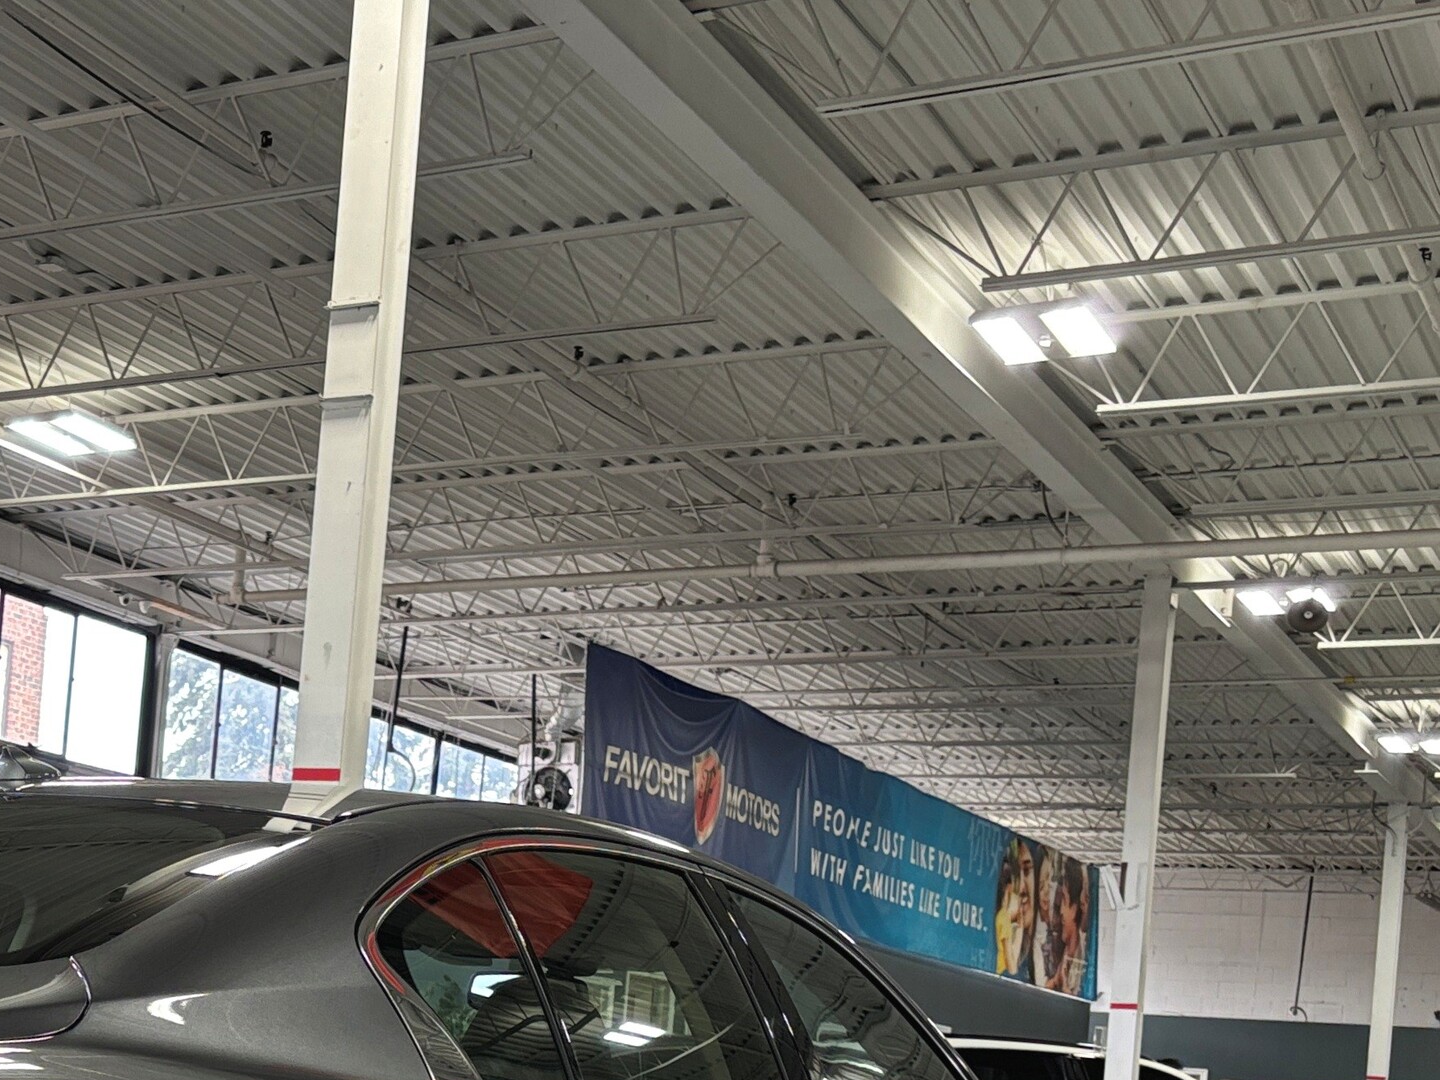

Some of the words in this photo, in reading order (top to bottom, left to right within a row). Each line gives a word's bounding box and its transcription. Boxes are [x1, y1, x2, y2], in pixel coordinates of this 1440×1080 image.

[603, 745, 690, 804] FAVORIT
[725, 783, 780, 837] MOTORS
[811, 847, 848, 886] WITH
[853, 864, 915, 909] FAMILIES
[918, 887, 940, 918] LIKE
[945, 896, 989, 932] YOURS.
[873, 826, 905, 860] JUST
[910, 838, 935, 871] LIKE
